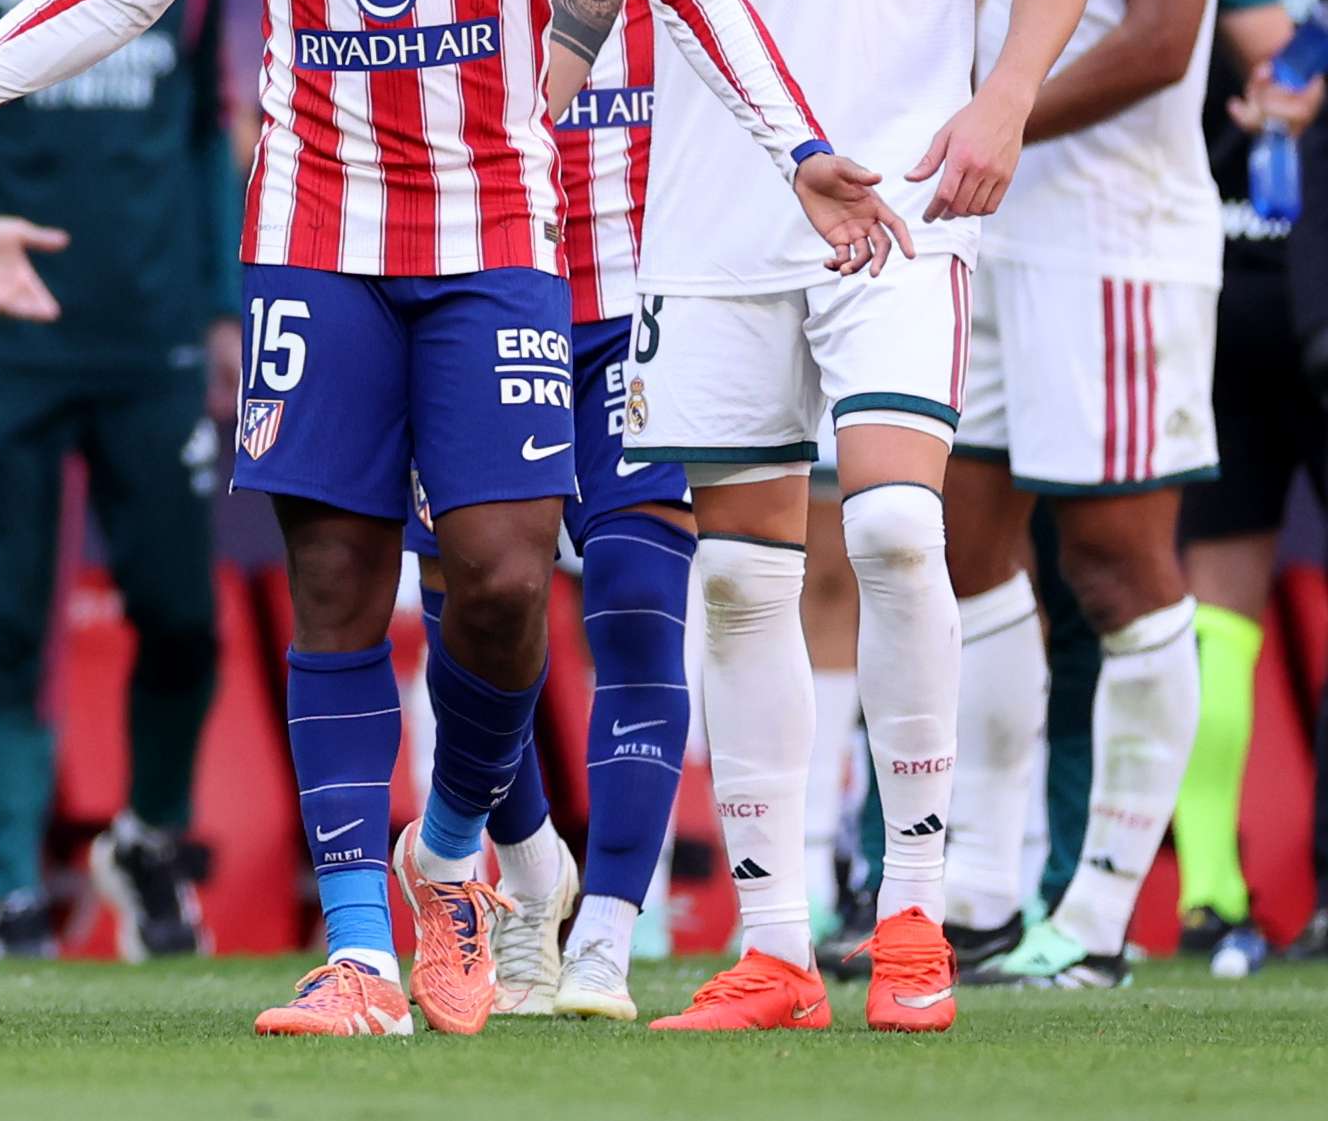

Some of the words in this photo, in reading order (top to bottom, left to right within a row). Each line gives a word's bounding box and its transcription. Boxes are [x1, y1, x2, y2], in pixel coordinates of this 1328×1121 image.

[301, 33, 426, 66] RIYADH
[436, 23, 495, 61] AIR
[248, 297, 311, 392] 15
[496, 328, 569, 365] ERGO
[500, 378, 571, 410] DKV
[892, 756, 953, 775] RMCF
[324, 847, 363, 862] ATLETI
